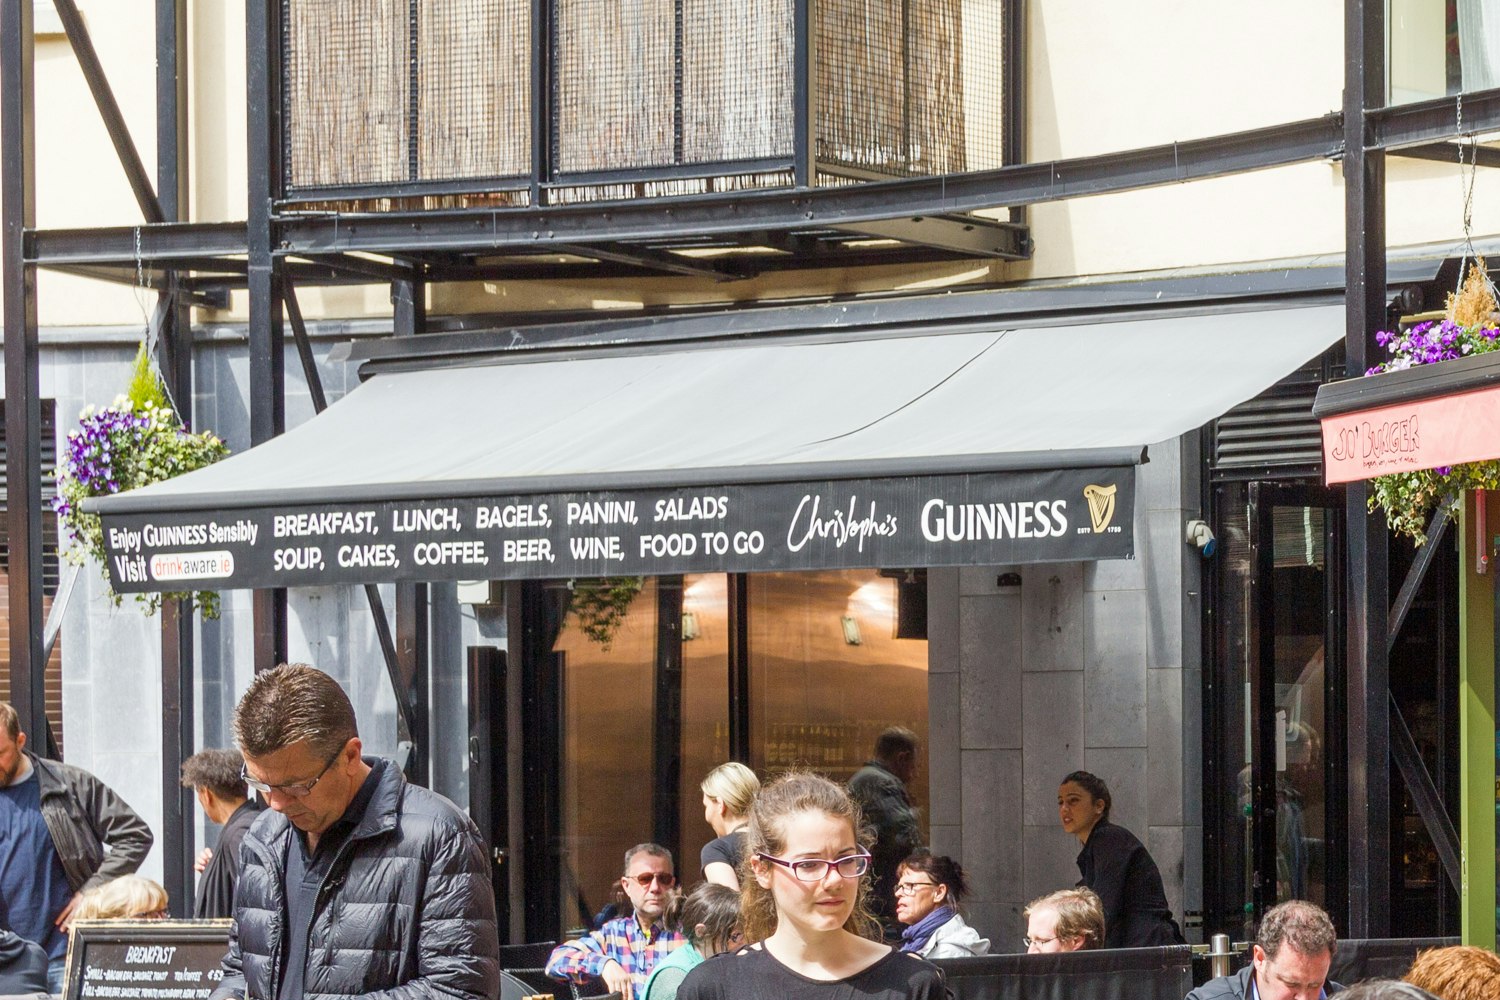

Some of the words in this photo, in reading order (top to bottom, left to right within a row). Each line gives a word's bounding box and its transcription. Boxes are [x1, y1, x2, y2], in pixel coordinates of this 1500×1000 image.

[1362, 414, 1420, 459] BURGER
[109, 528, 141, 553] Enjoy
[143, 523, 207, 547] GUINNESS
[209, 520, 259, 545] Sensibly
[273, 510, 379, 538] BREAKFAST,
[393, 507, 462, 534] LUNCH,
[475, 503, 553, 530] BAGELS,
[567, 500, 639, 527] PANINI,
[654, 496, 729, 523] SALADS
[921, 498, 1069, 542] GUINNESS
[115, 554, 148, 583] Visit
[155, 556, 231, 577] drinkaware.ie
[273, 548, 325, 573] SOUP,
[337, 544, 400, 569] CAKES,
[413, 540, 490, 568] COFFEE,
[503, 537, 556, 565] BEER,
[569, 535, 625, 562] WINE,
[639, 532, 697, 558] FOOD
[701, 531, 729, 555] TO
[733, 530, 764, 555] GO
